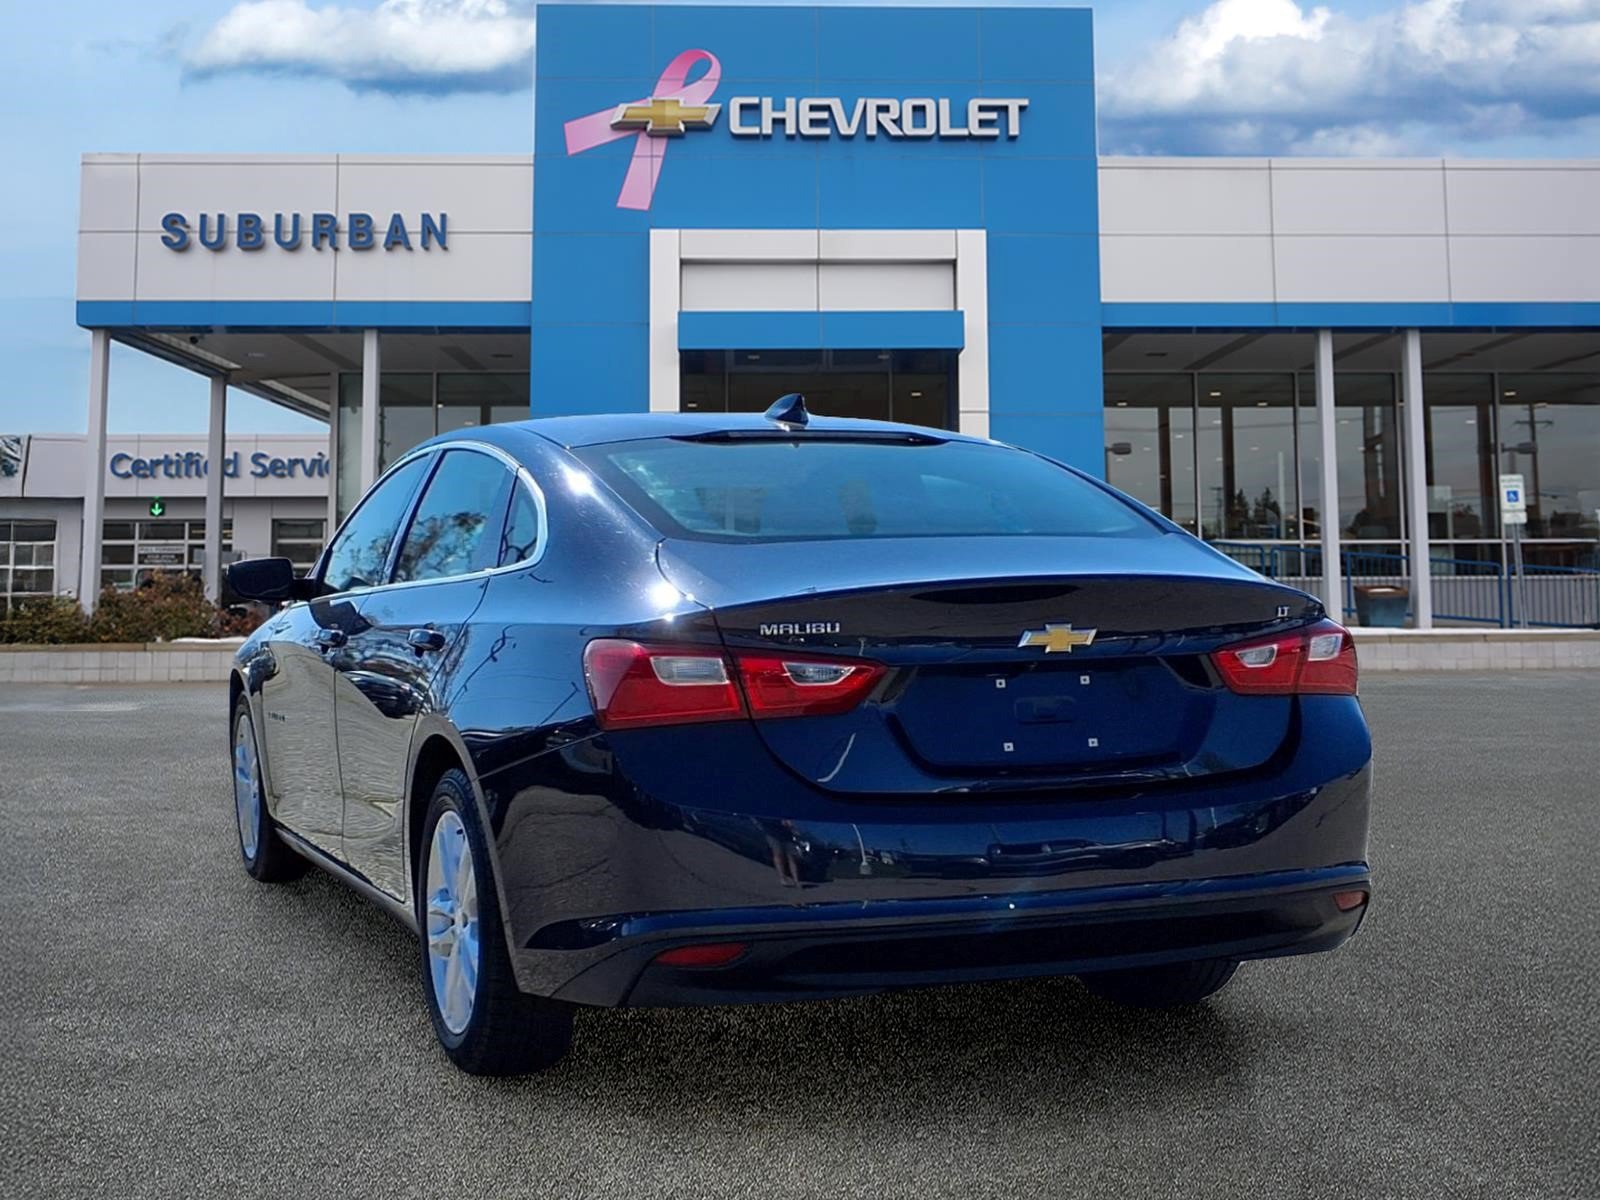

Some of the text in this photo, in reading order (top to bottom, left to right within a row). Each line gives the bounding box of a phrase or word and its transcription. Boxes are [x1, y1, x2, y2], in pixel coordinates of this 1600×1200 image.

[729, 97, 1029, 137] CHEVROLET
[161, 212, 449, 251] SUBURBAN
[110, 452, 239, 479] Certifid
[760, 622, 840, 635] MALIBU
